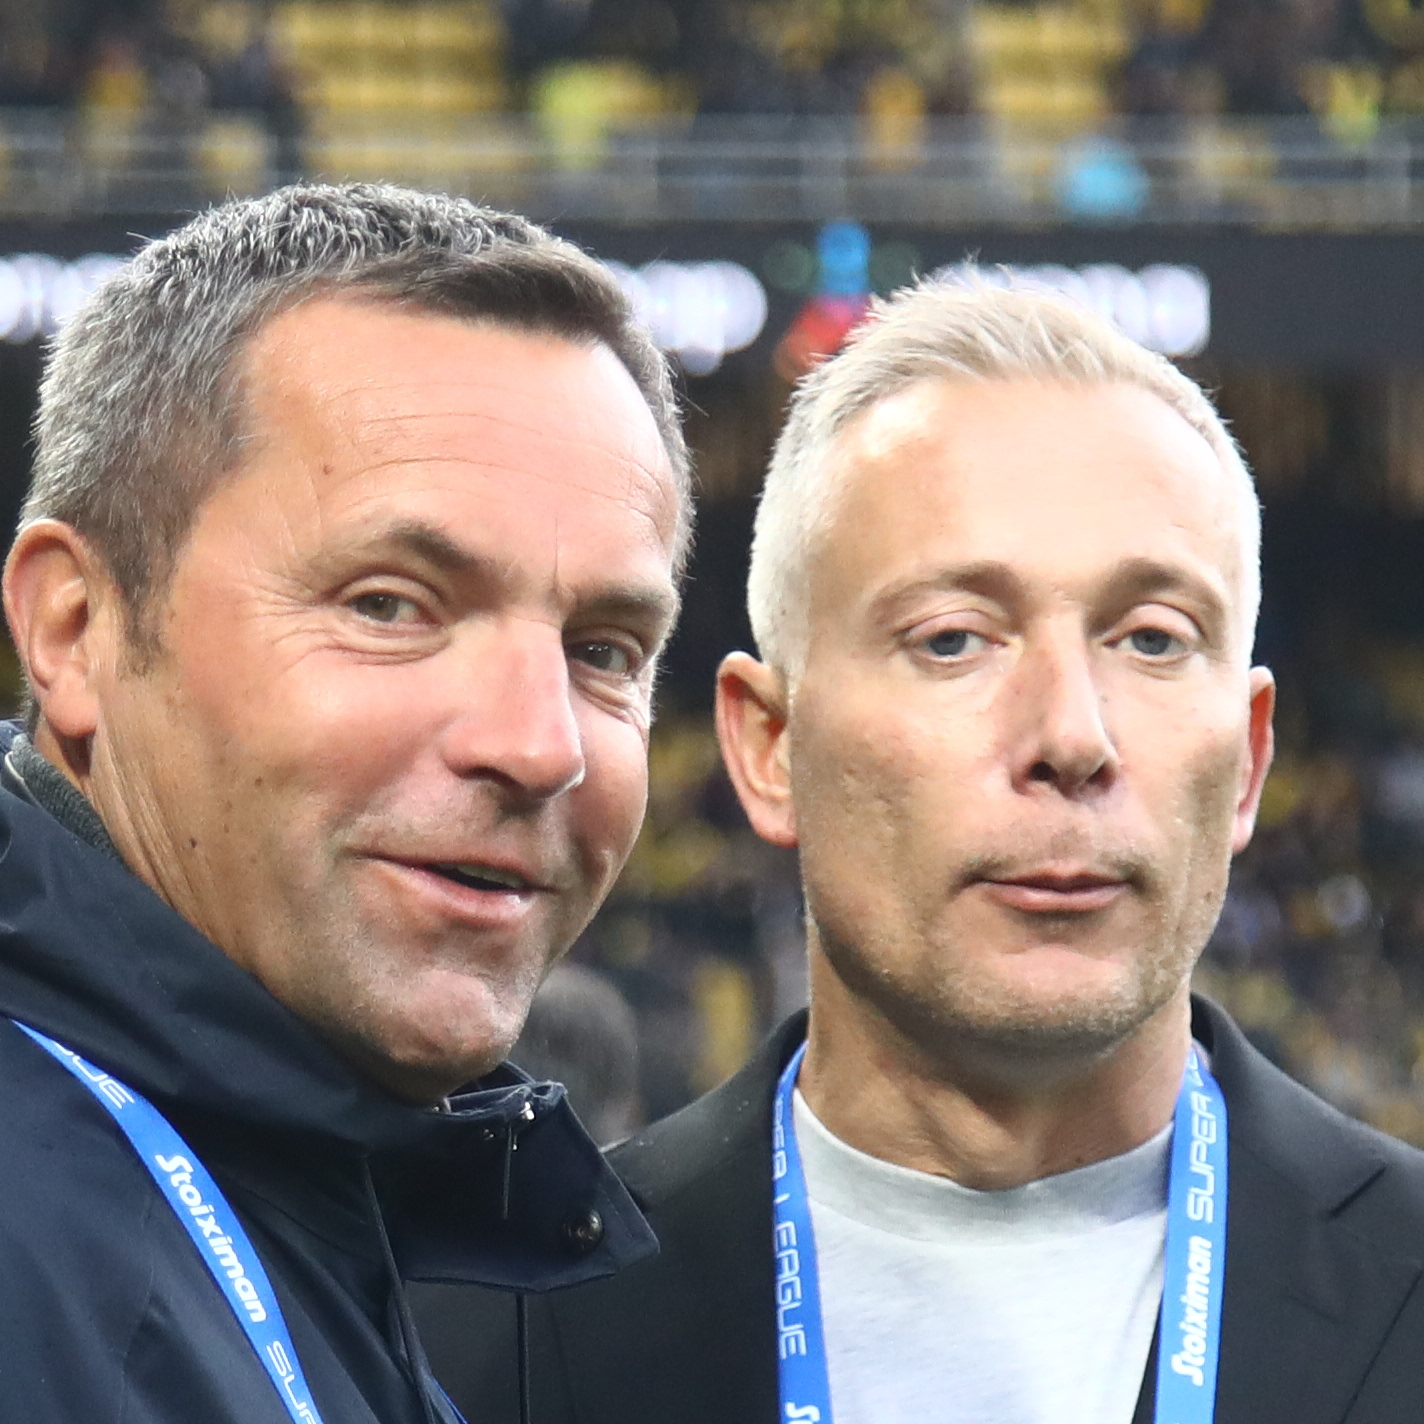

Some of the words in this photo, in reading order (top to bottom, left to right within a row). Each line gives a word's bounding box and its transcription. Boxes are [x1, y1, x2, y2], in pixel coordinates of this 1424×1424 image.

[1186, 1096, 1216, 1225] SUPER
[154, 1152, 267, 1323] Stoiximan
[1171, 1236, 1213, 1388] Stoiximan
